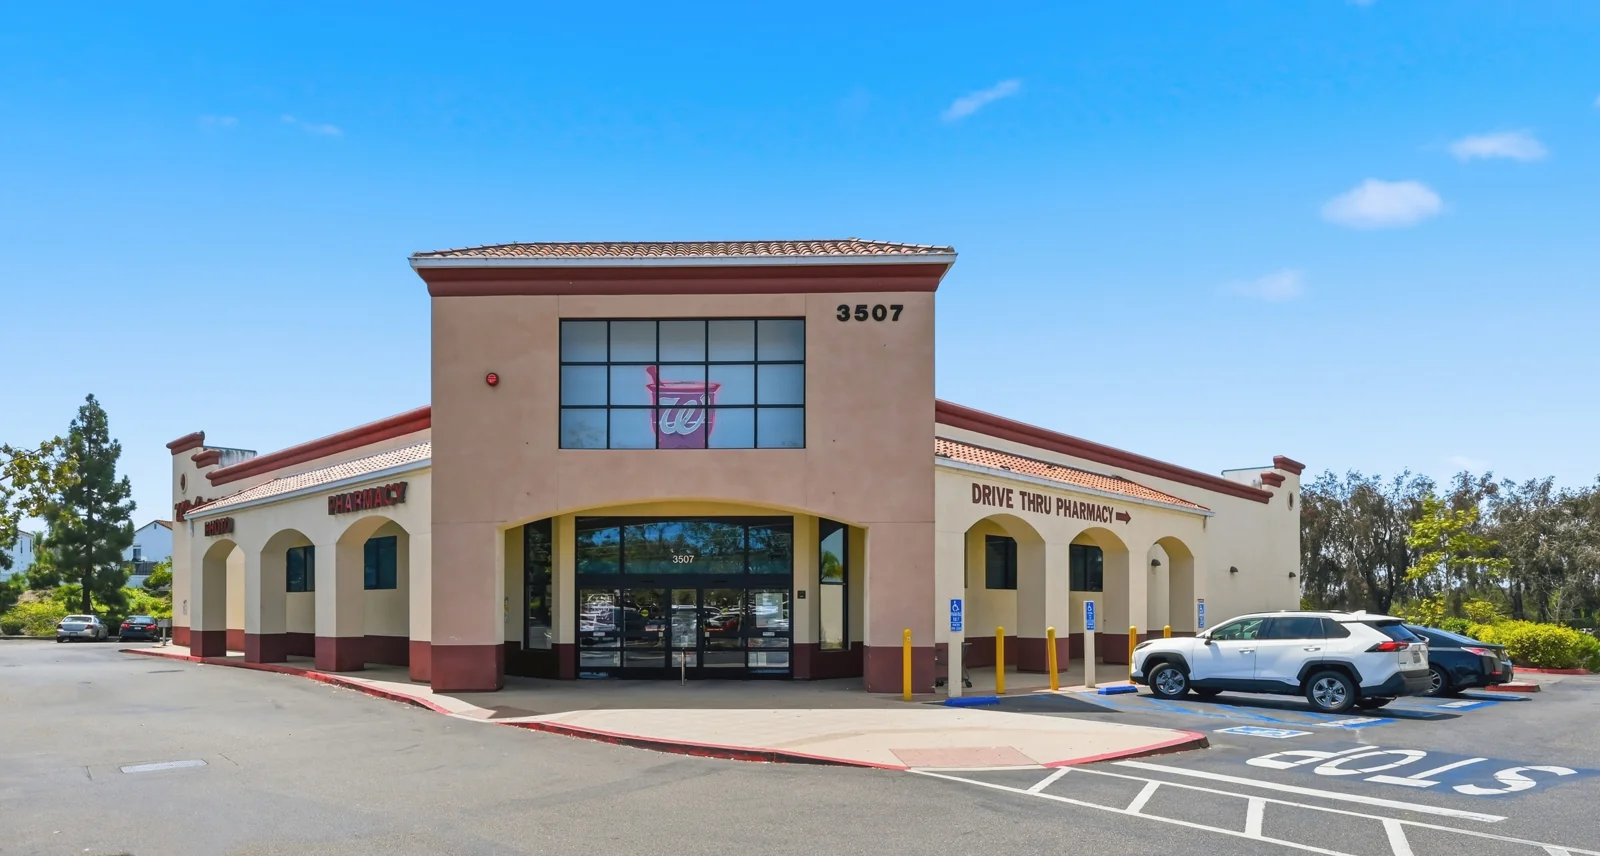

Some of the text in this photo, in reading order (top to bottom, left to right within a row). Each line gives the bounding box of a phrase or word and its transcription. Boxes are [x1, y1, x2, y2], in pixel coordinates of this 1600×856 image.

[836, 304, 904, 322] 3507
[328, 481, 408, 515] PHARMACY
[971, 482, 1114, 523] DRIVE THRU PHARMACY
[672, 554, 695, 564] 3507
[1245, 745, 1578, 795] STOP
